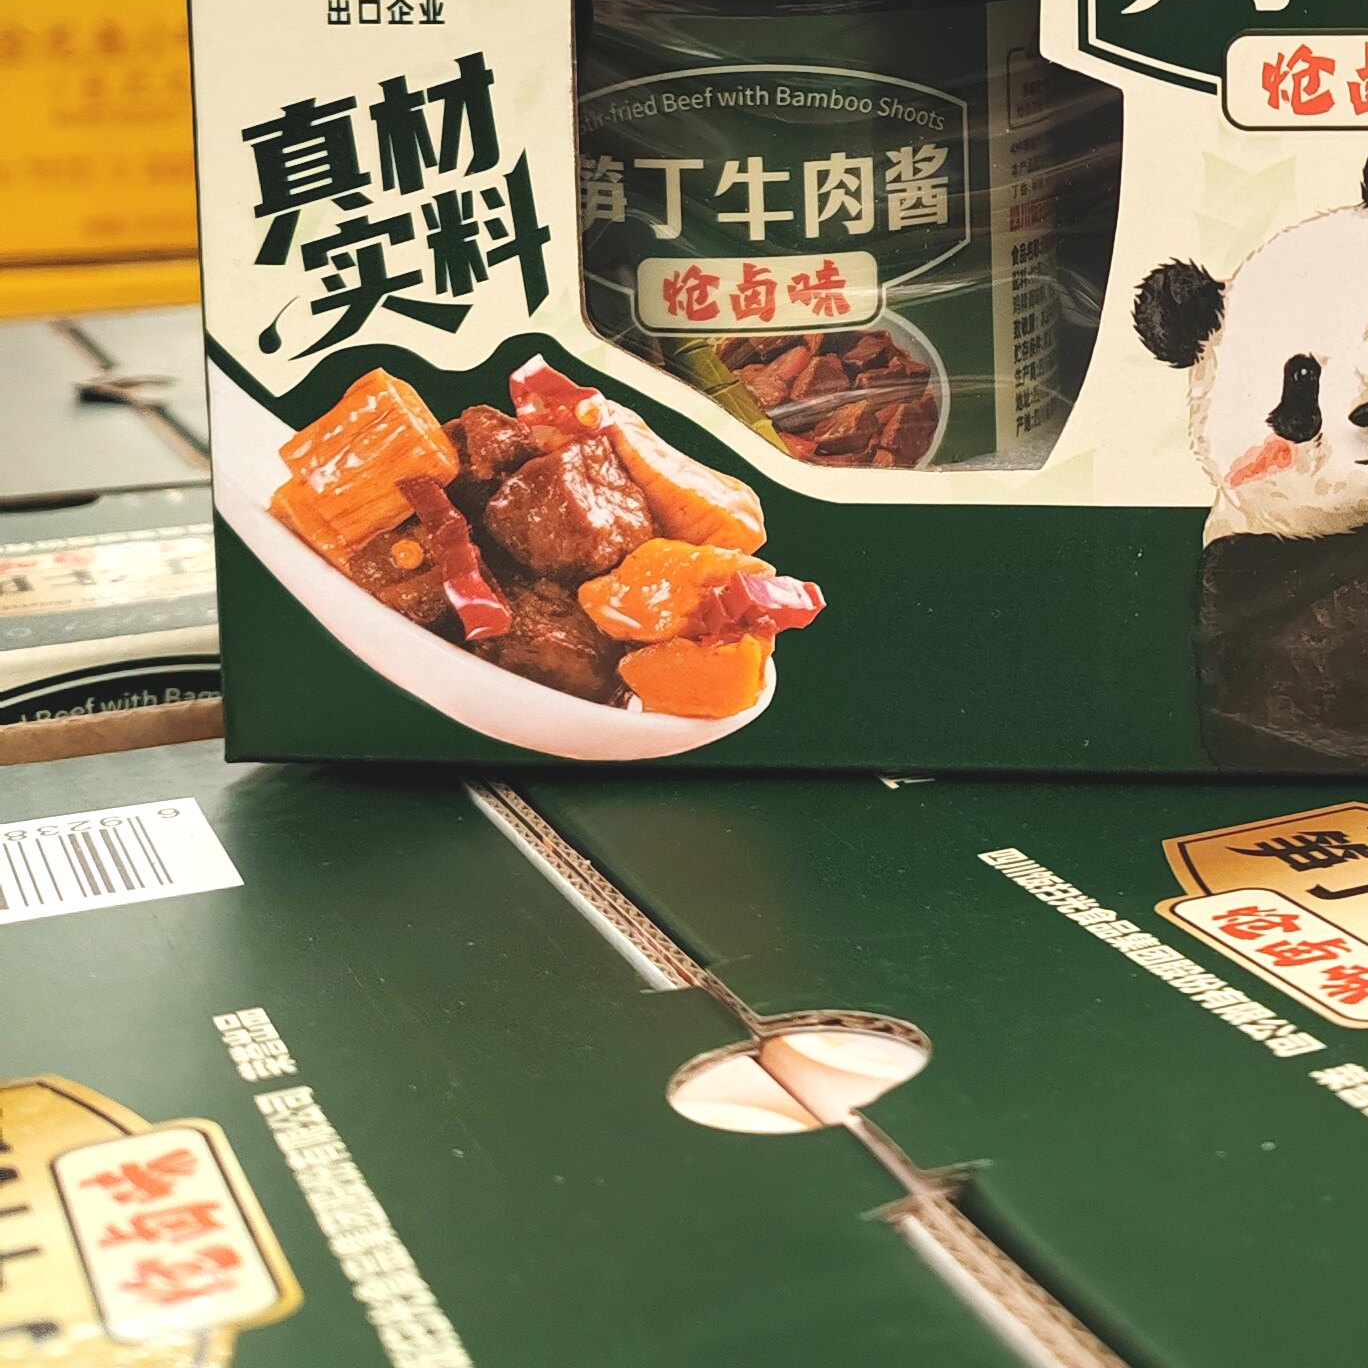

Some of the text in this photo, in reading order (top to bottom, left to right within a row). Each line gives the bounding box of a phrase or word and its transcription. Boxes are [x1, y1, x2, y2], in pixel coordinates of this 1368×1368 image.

[241, 50, 502, 266] 真材
[662, 86, 714, 115] Beef
[716, 86, 770, 108] with
[776, 86, 874, 115] Bamboo
[877, 97, 946, 131] Shoots
[286, 147, 552, 361] 实料
[662, 259, 852, 323] 炝卤味
